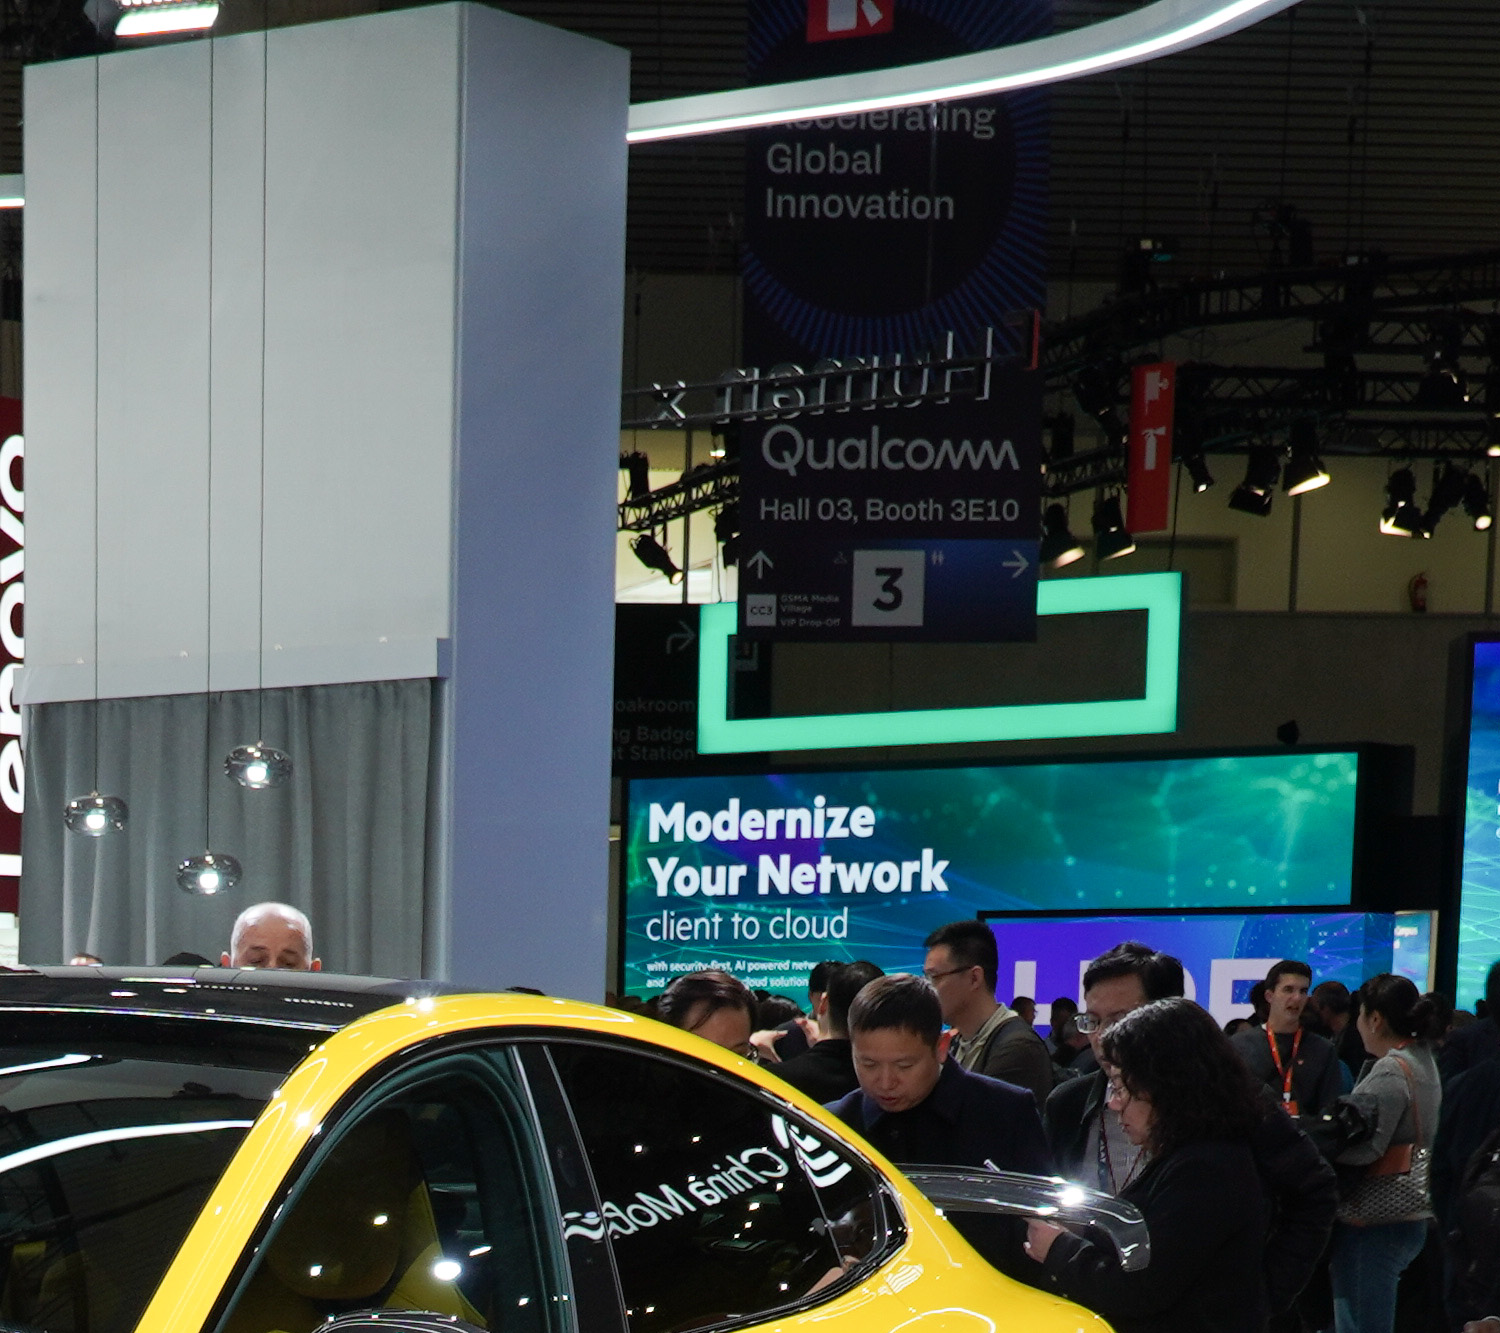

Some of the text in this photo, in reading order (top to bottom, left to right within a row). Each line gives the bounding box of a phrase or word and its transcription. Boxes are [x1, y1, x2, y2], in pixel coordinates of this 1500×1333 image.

[767, 144, 882, 174] Global
[766, 187, 954, 220] Innovation
[761, 424, 1021, 477] Qualcomm
[760, 498, 1020, 525] Hall 03, Booth 3E10
[872, 567, 904, 612] 3
[615, 697, 697, 713] oakroom
[649, 795, 876, 843] Modernize
[647, 848, 950, 897] Your Network
[646, 906, 849, 941] client to cloud
[646, 960, 668, 972] with
[747, 960, 790, 973] powered
